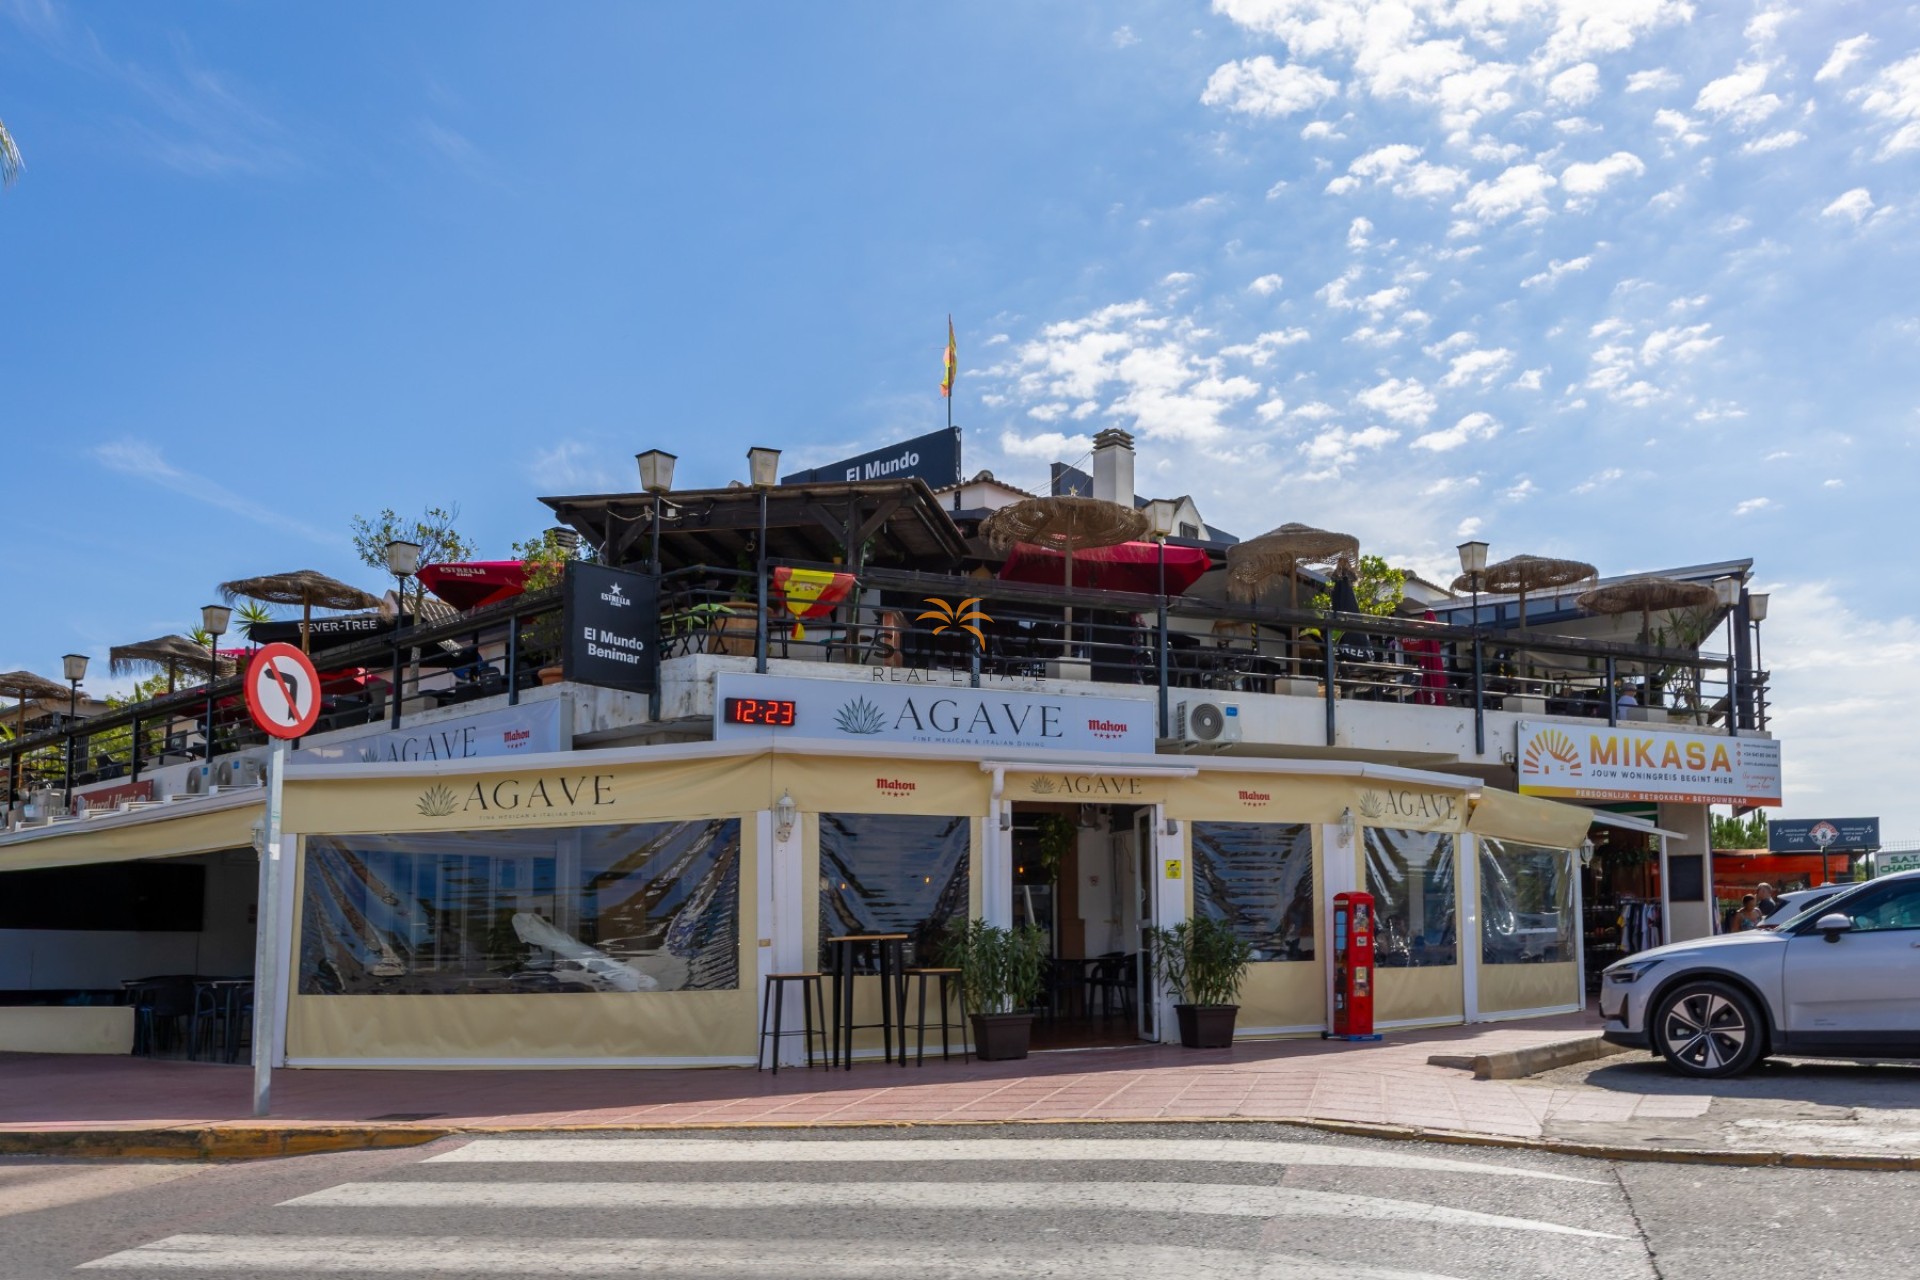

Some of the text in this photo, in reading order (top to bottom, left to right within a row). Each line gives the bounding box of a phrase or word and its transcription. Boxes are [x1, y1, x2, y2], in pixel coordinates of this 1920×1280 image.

[846, 451, 920, 482] El Mundo
[440, 566, 486, 575] ESTRELLA
[601, 592, 631, 606] ESTRELLA
[584, 627, 644, 651] El Mundo
[588, 642, 640, 664] Benimar
[736, 700, 794, 724] 12:23
[893, 697, 1128, 738] AGAVE Mahou
[387, 726, 530, 761] AGAVE Mahou
[1589, 733, 1732, 773] MIKASA
[877, 778, 916, 791] Mahou
[1058, 776, 1142, 795] AGAVE
[1591, 769, 1617, 778] JOUW
[1621, 770, 1678, 781] WONINGREIS
[1680, 773, 1711, 783] BEGINT
[1714, 776, 1734, 784] HIER
[463, 775, 616, 811] AGAVE
[1239, 790, 1271, 801] Mahou
[1384, 789, 1457, 820] AGAVE
[1575, 789, 1748, 804] PERSOONLIJK BETROKKEN BETROUWBAAR
